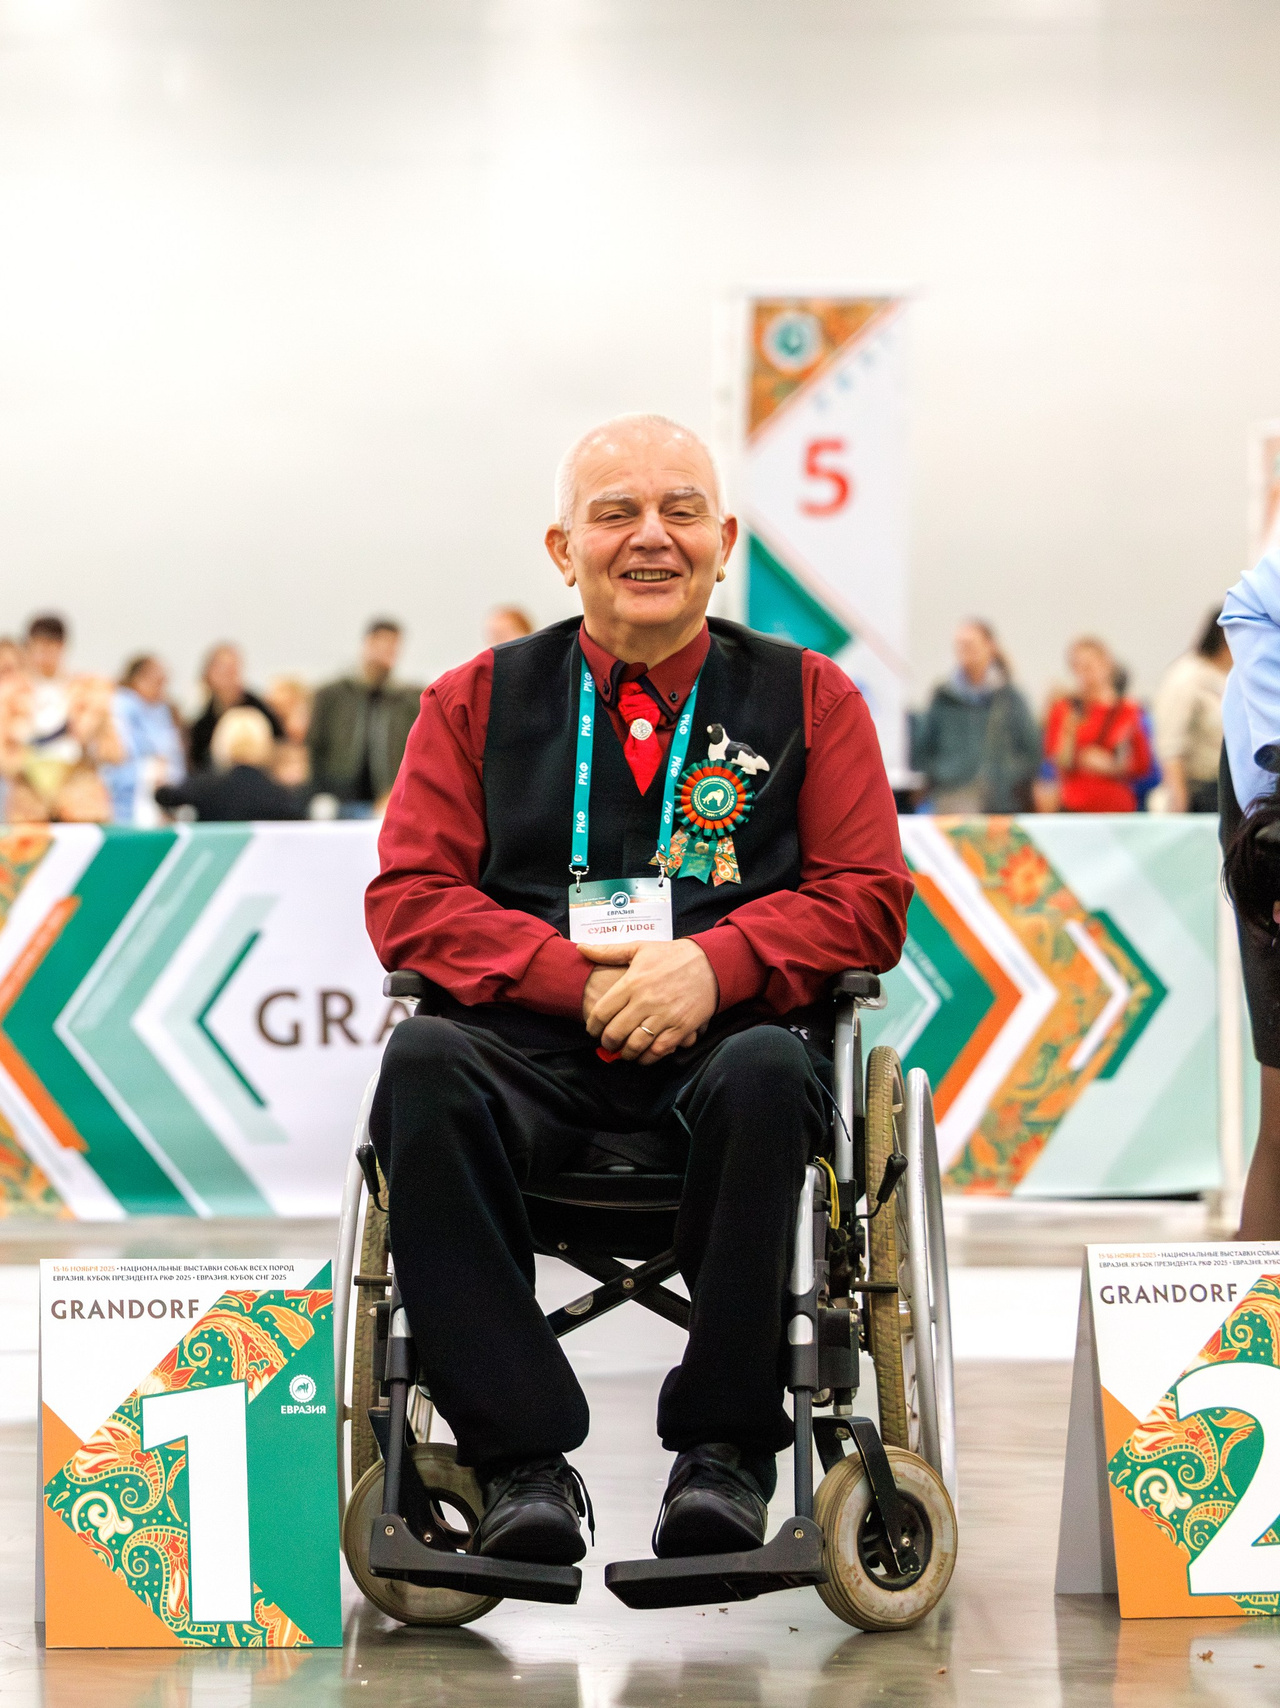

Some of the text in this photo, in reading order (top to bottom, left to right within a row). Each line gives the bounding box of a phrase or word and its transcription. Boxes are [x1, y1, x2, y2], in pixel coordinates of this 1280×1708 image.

[796, 433, 853, 520] 5
[583, 671, 595, 693] РКФ
[581, 714, 592, 737] РКФ
[678, 713, 691, 735] РКФ
[578, 761, 589, 785] РКФ
[669, 755, 682, 778] РКФ
[576, 810, 586, 833] РКФ
[663, 800, 673, 824] РКФ
[607, 909, 635, 917] ЕВРАЗИЯ
[588, 925, 618, 934] СУДЬЯ
[626, 923, 656, 933] JUDGE
[120, 1265, 182, 1273] НАЦИОНАЛЬНЫЕ
[269, 1264, 295, 1272] ПОРОД
[1099, 1283, 1238, 1305] GRANDORF
[51, 1298, 200, 1320] GRANDORF
[280, 1405, 327, 1414] ЕВРАЗИЯ
[1175, 1361, 1280, 1596] 2
[142, 1380, 252, 1622] 1
